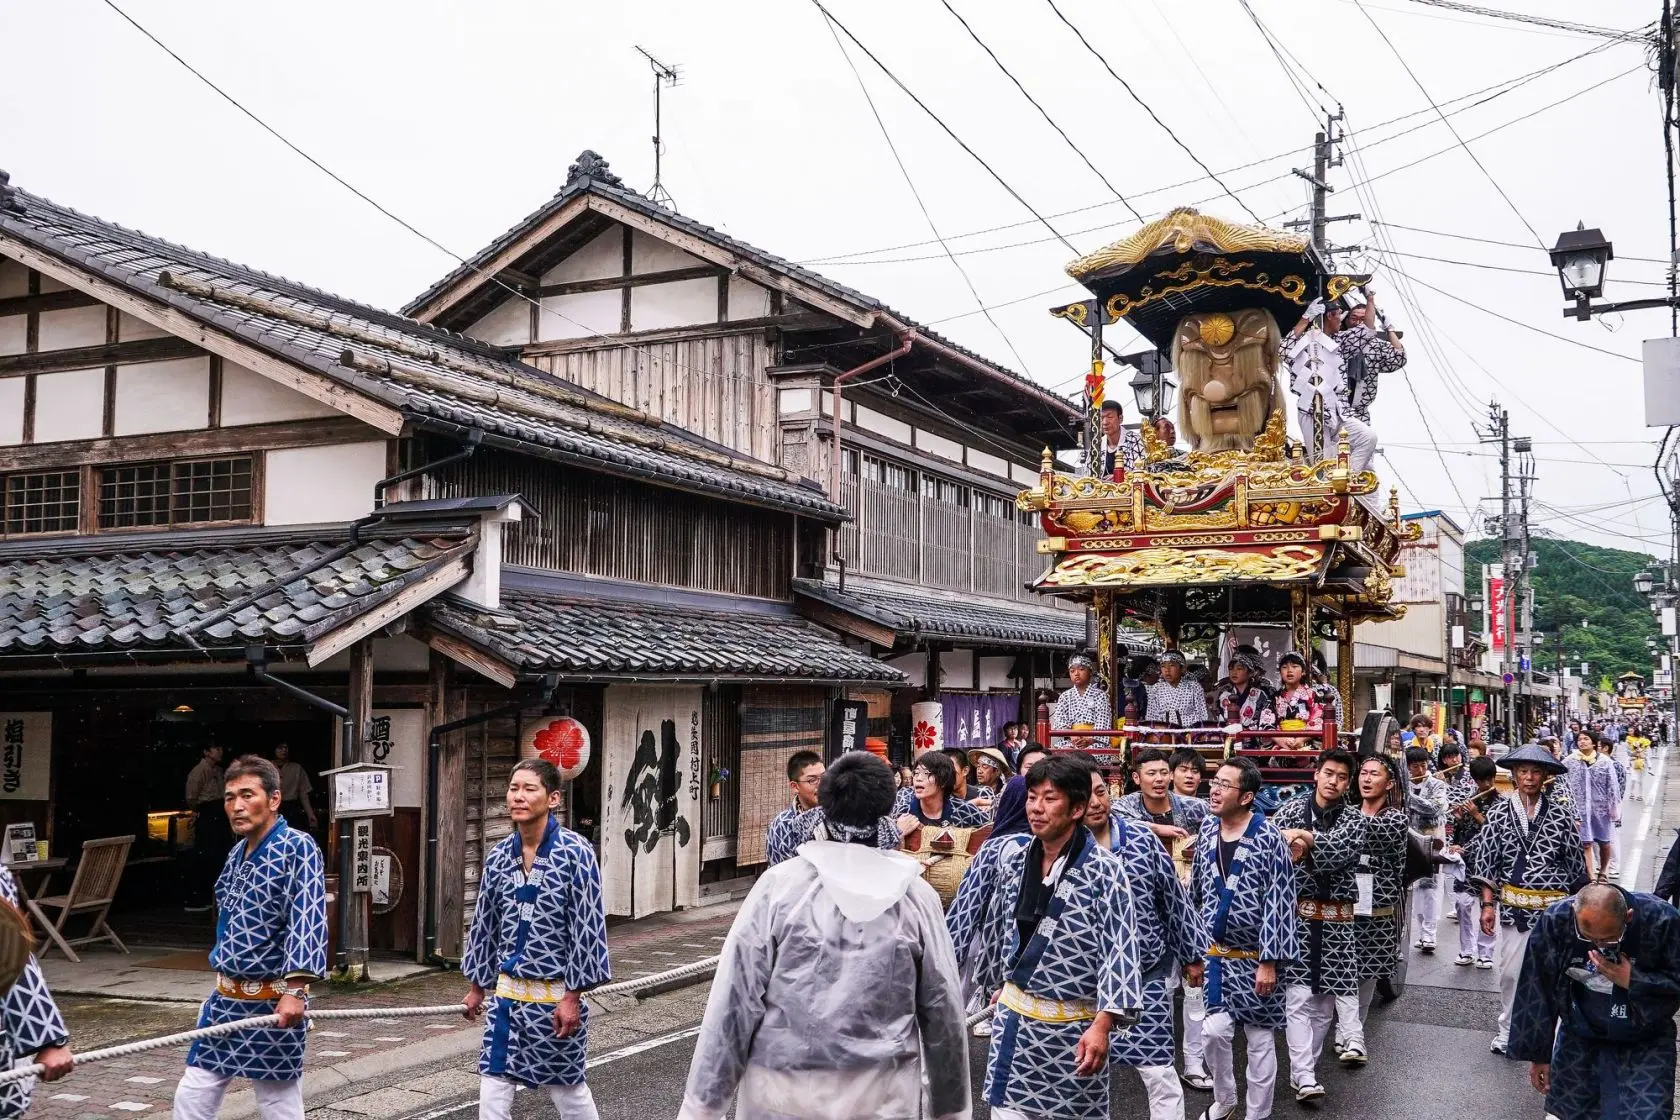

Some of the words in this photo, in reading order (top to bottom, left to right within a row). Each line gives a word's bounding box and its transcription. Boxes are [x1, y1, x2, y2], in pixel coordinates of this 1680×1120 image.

[371, 716, 395, 765] 酒び
[357, 825, 369, 887] 観光案内所
[1611, 1003, 1628, 1019] 組
